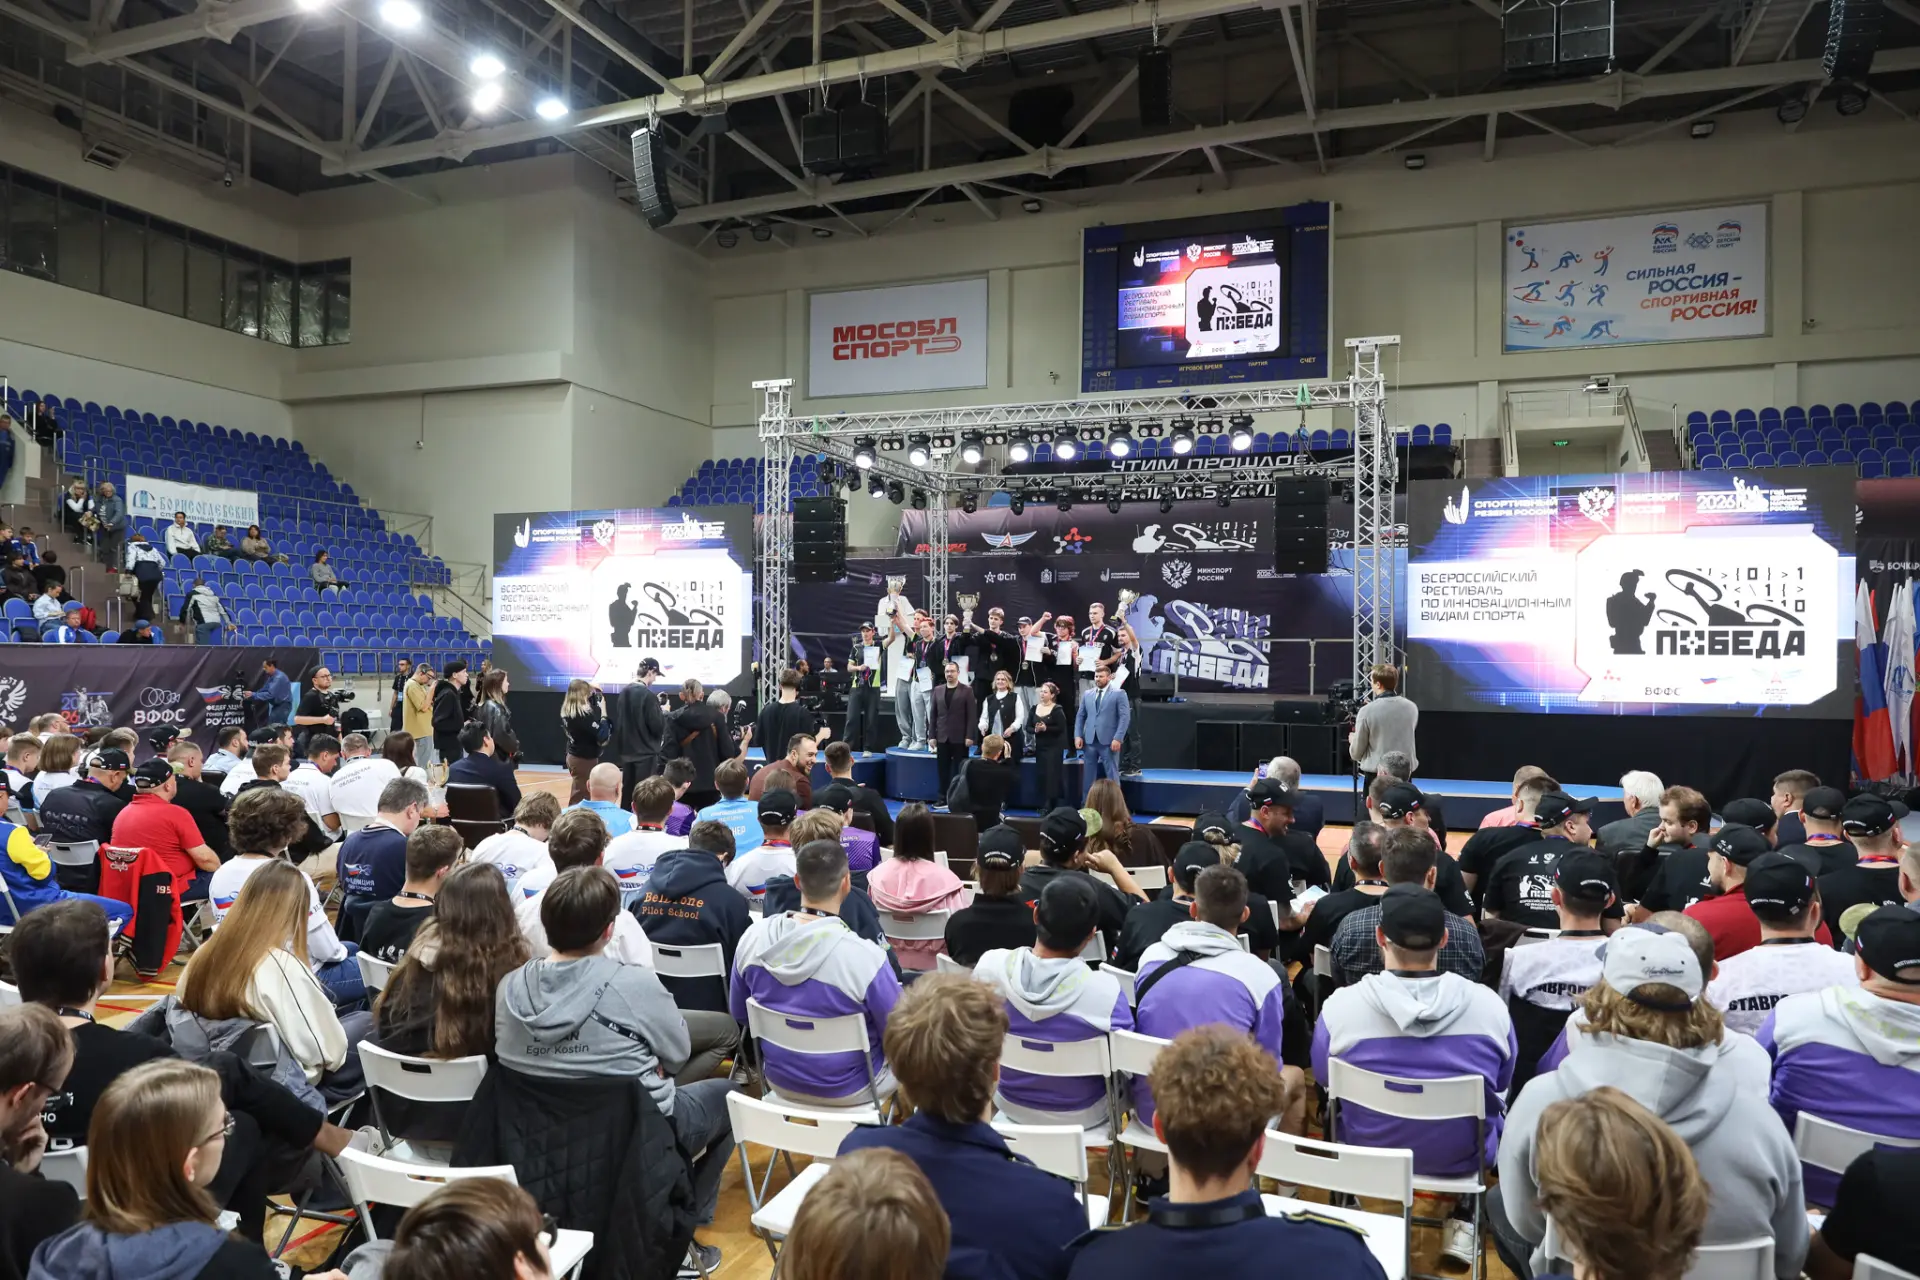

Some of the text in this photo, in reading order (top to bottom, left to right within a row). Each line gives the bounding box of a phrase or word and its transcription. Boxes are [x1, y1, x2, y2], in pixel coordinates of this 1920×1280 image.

[1626, 263, 1696, 281] СИЛЬНАЯ
[1648, 272, 1729, 294] РОССИЯ
[1640, 288, 1740, 309] СПОРТИВНАЯ
[1671, 299, 1758, 322] РОССИЯ!
[833, 318, 957, 343] МОСОБЛ
[833, 338, 929, 360] СПОРТ
[1111, 459, 1179, 472] ЧТИМ
[1474, 496, 1558, 508] СПОРТИВНЫЙ
[1697, 494, 1736, 510] 2026
[1421, 570, 1537, 583] ВСЕРОССИЙСКИЙ
[1421, 586, 1503, 596] ФЕСТИВАЛЬ
[1421, 597, 1571, 609] ПО ИННОВАЦИОННЫМ
[1421, 610, 1526, 622] ВИДАМ СПОРТА
[1656, 630, 1805, 659] ПОБЕДА
[1644, 687, 1681, 696] ВФФС
[134, 708, 186, 725] ВФФС
[641, 906, 699, 920] Pilot School
[526, 1043, 589, 1057] Egor Kostin
